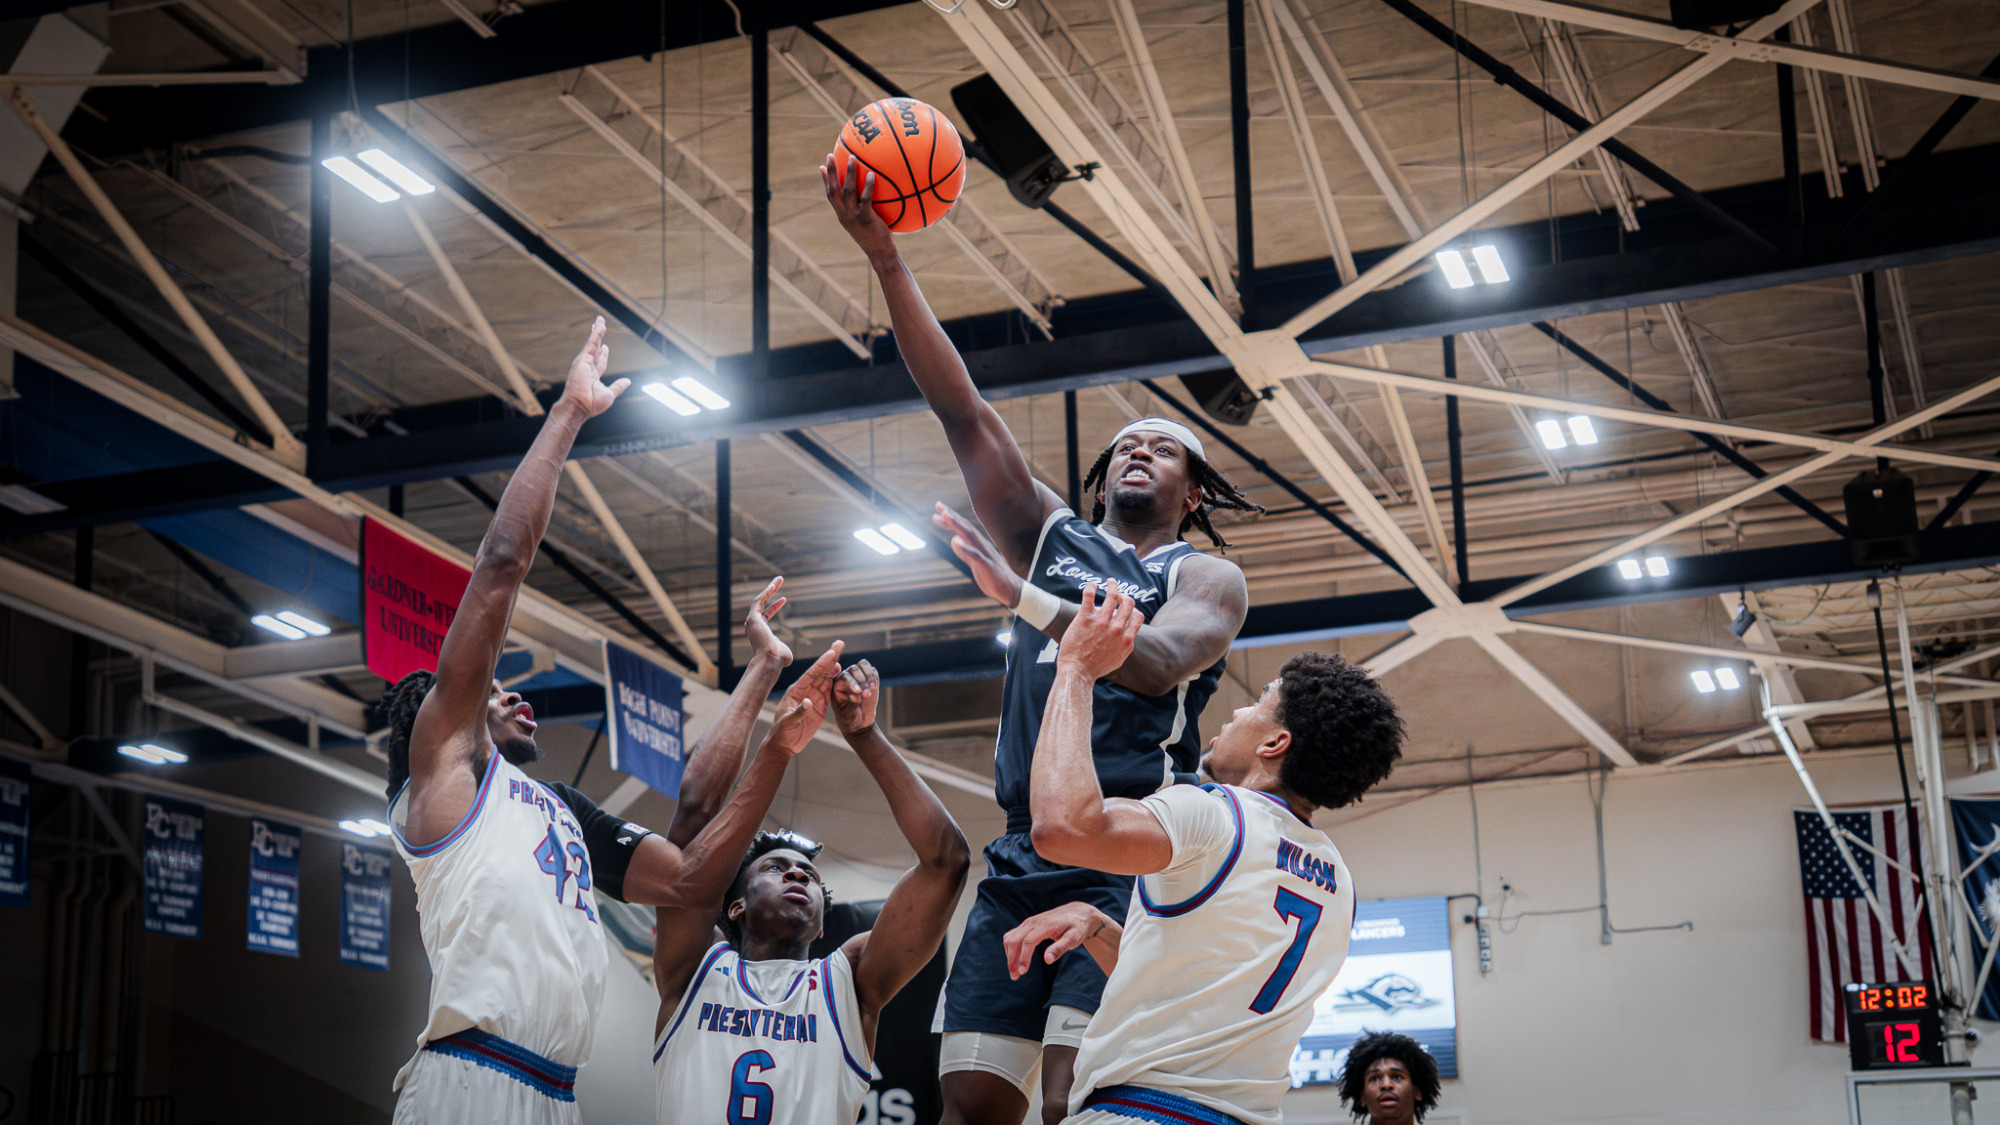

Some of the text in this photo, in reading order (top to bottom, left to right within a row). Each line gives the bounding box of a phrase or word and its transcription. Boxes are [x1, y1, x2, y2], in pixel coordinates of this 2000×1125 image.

[533, 823, 599, 925] 42
[1275, 837, 1337, 894] WILSON
[1248, 885, 1324, 1015] 7
[1350, 925, 1406, 941] LANCERS
[1859, 985, 1928, 1010] 12:02
[1884, 1023, 1920, 1063] 12
[726, 1048, 776, 1125] 6
